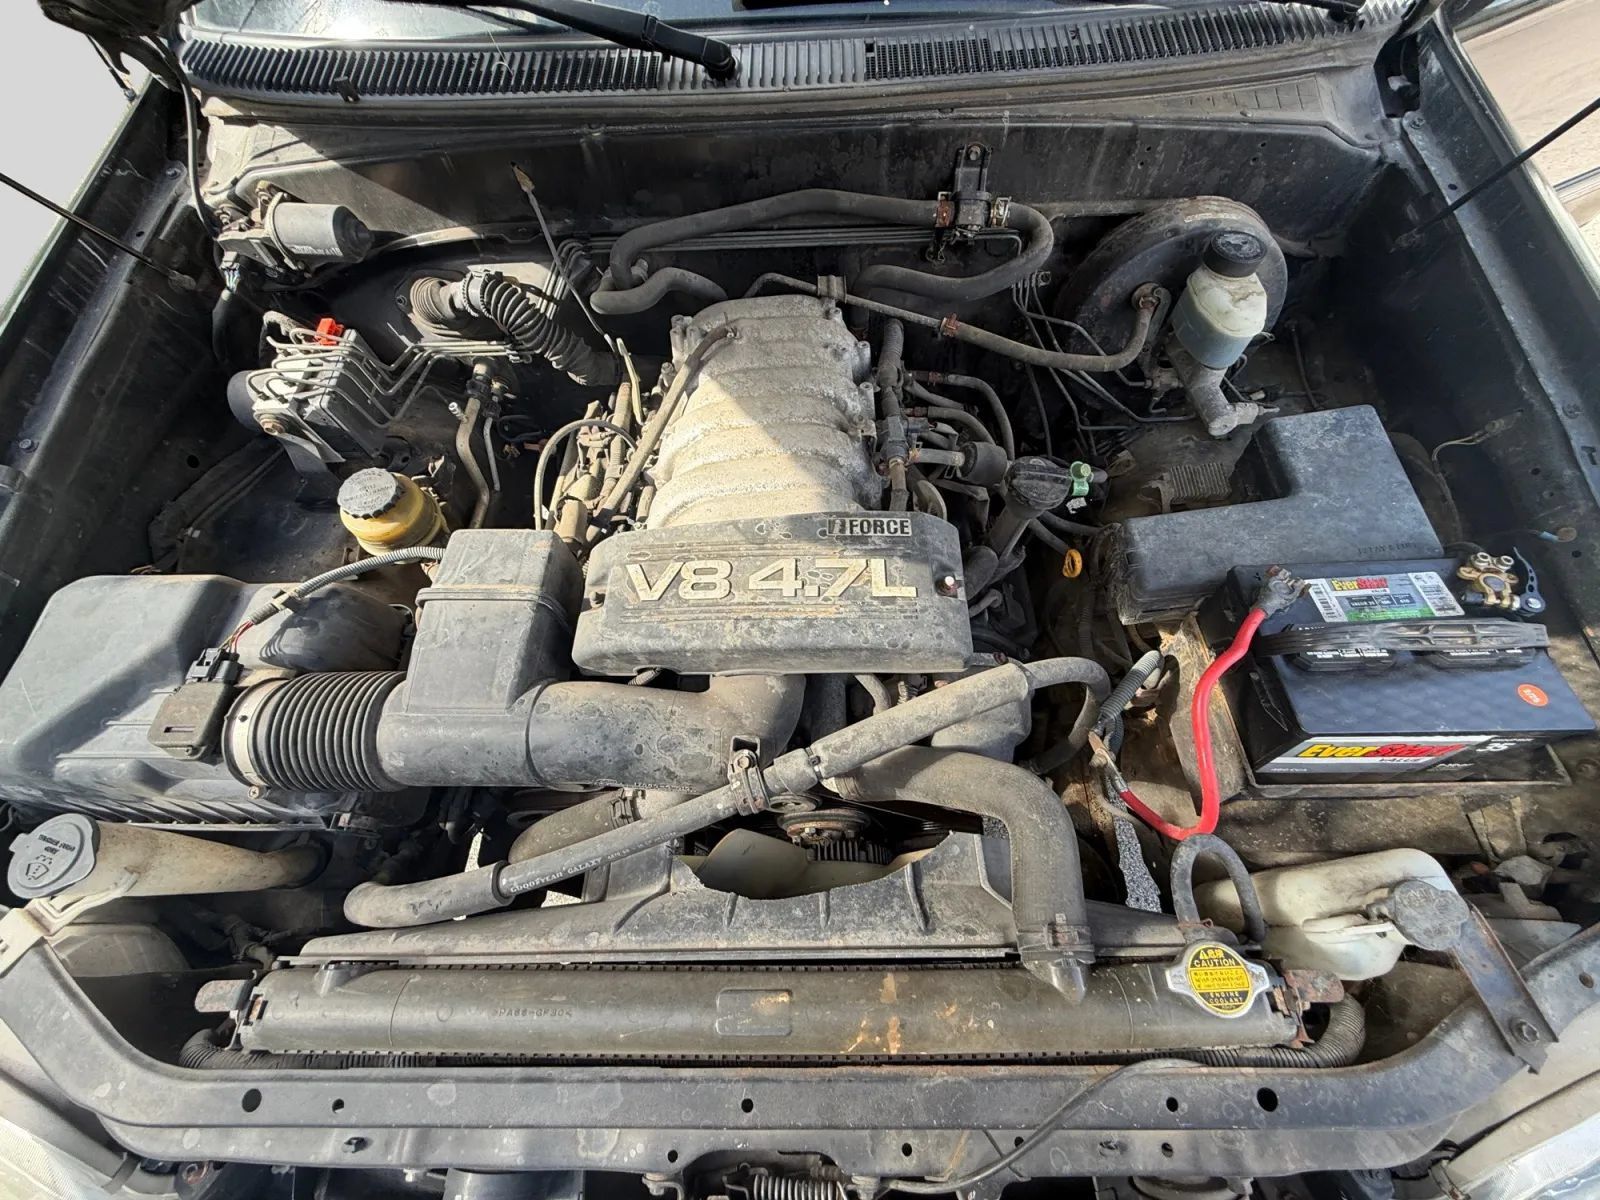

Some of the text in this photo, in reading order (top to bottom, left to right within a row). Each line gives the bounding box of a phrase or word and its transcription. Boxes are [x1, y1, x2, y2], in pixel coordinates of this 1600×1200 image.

[625, 558, 917, 601] V8 4.7L
[510, 857, 602, 893] GOODYEAR GALAXY
[1193, 957, 1236, 968] CAUTION
